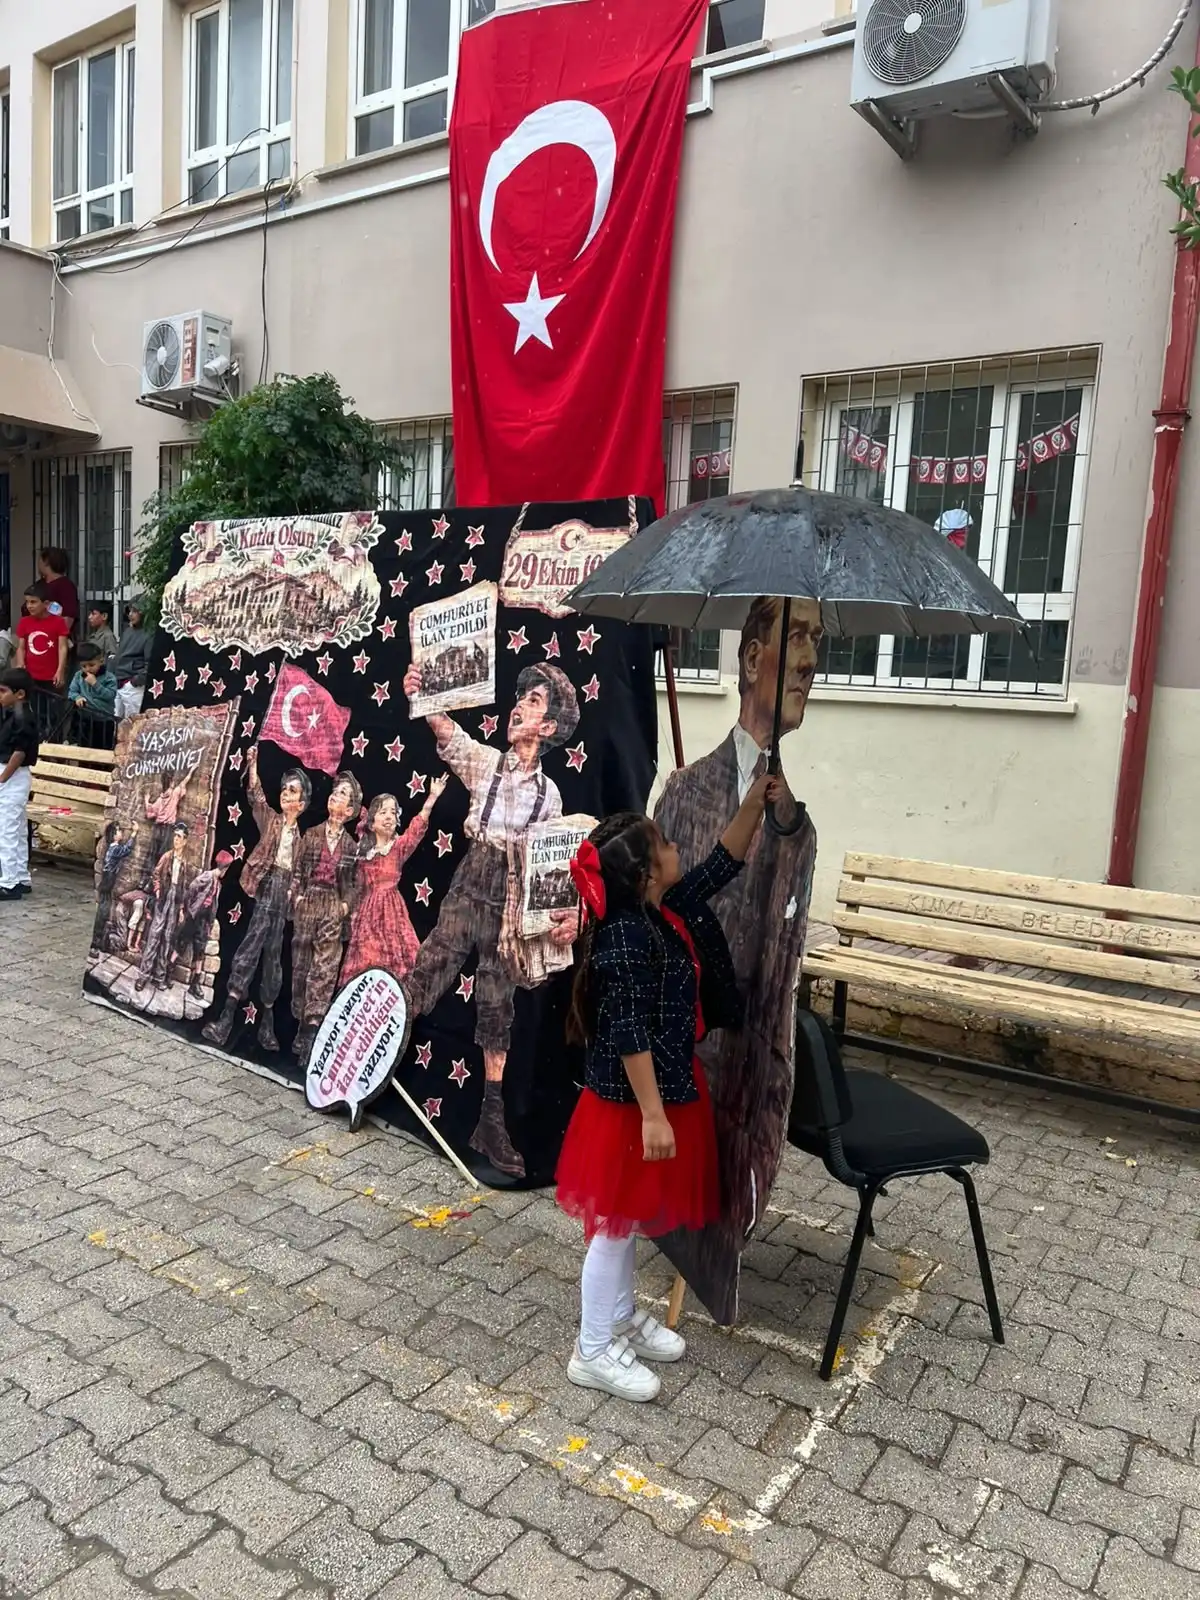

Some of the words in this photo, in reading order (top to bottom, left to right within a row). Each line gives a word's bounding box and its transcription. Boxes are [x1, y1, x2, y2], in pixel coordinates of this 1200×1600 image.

[239, 525, 275, 550] Kutlu
[278, 524, 315, 549] Olsun
[505, 553, 538, 589] 29
[538, 558, 579, 585] Ekim
[420, 596, 490, 631] CUMHURİYET
[421, 630, 446, 647] İLAN
[450, 612, 488, 638] EDİLDİ
[141, 725, 195, 752] YAŞASIN
[126, 746, 206, 779] CUMHURİYET
[531, 831, 587, 850] CUMHURİYET
[531, 851, 551, 864] İLAN
[310, 1022, 341, 1080] Yazıyor
[320, 979, 388, 1095] Cumhuriyet'in
[337, 1062, 358, 1096] ilan
[354, 989, 399, 1062] edildiğini
[358, 1016, 400, 1089] yazıyor!
